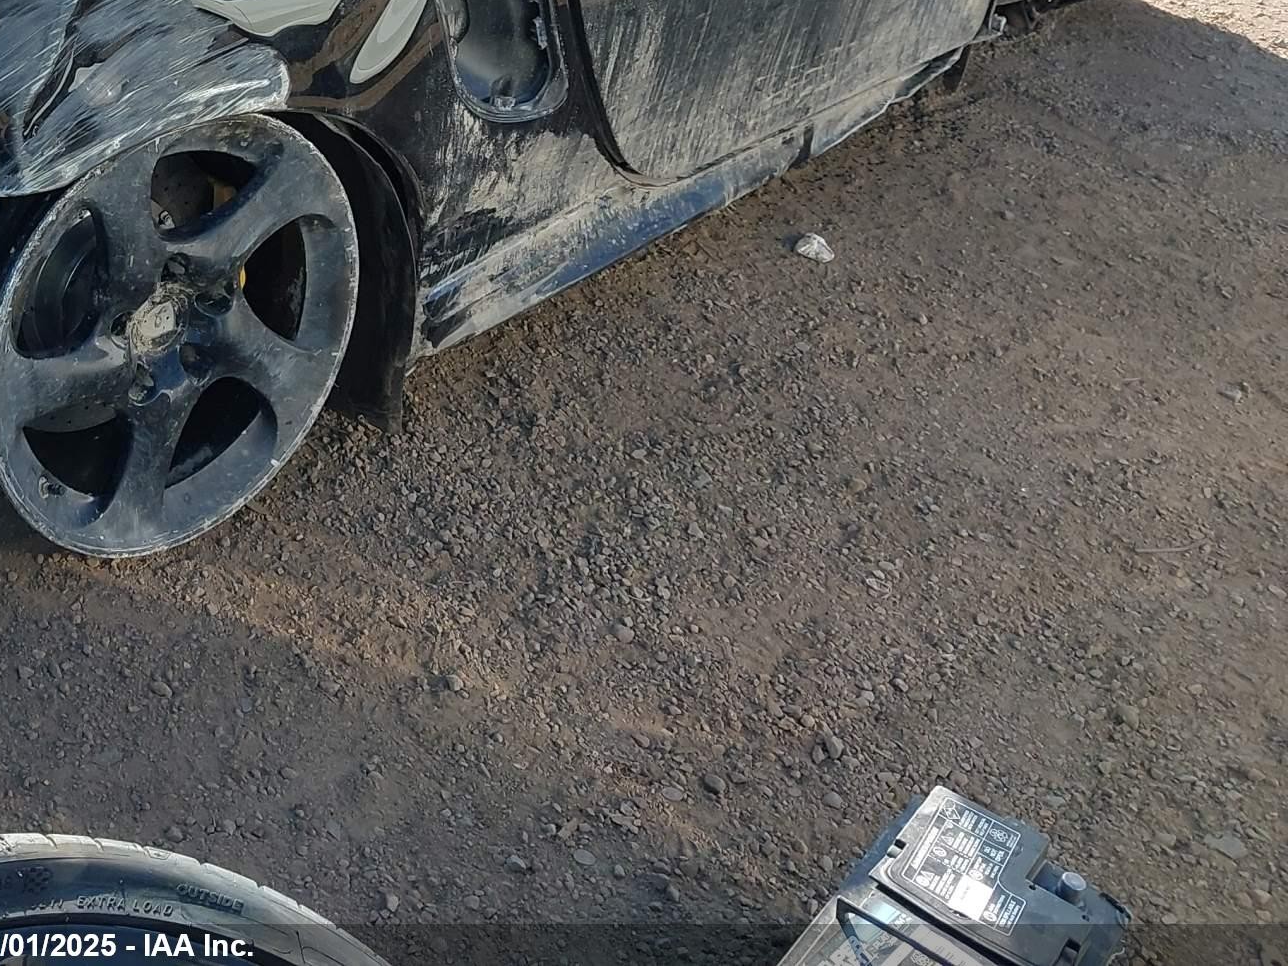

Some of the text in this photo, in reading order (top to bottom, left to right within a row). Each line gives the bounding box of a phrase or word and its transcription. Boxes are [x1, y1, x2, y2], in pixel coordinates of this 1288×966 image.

[76, 892, 126, 912] EXTRA
[132, 898, 174, 917] LOAD
[175, 882, 245, 915] OUTSIDE
